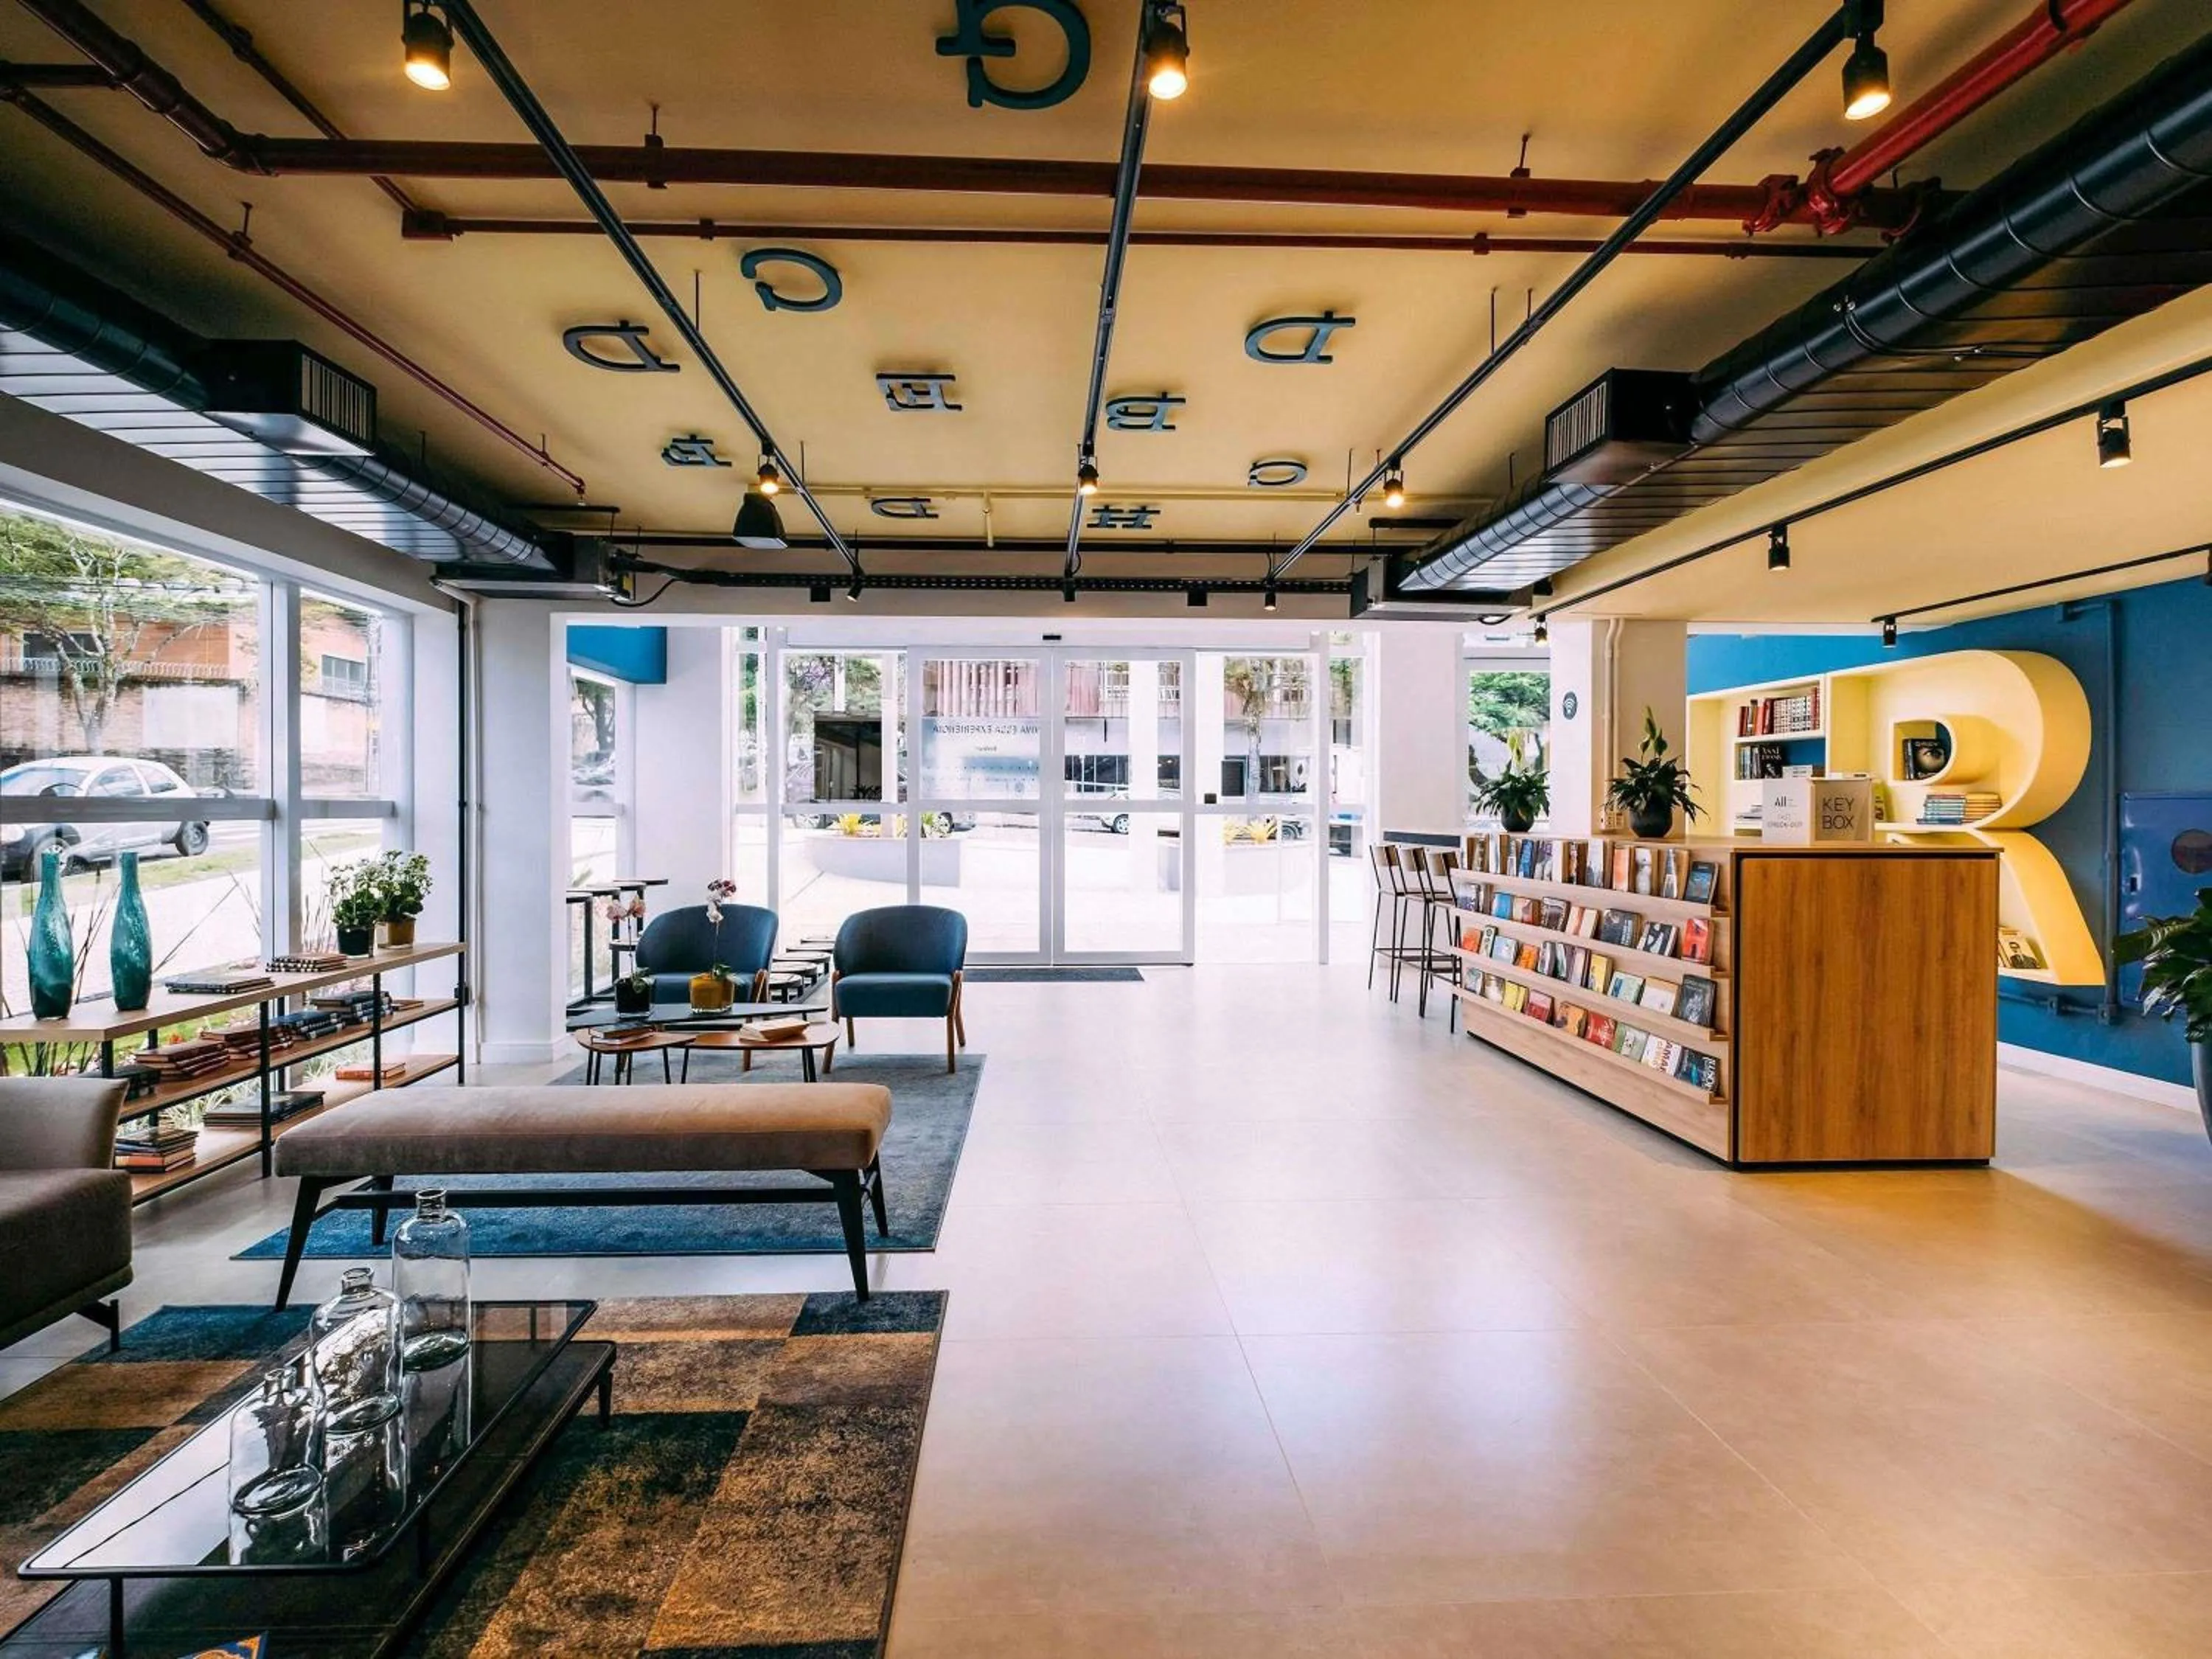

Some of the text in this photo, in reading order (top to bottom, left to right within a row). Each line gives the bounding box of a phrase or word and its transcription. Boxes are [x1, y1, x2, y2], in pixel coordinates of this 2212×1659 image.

[936, 0, 1091, 109] G
[740, 247, 843, 312] C
[563, 321, 681, 372] D
[1245, 312, 1355, 364] D
[875, 372, 963, 411] E
[1106, 392, 1186, 432] B
[1086, 504, 1161, 530] H
[1775, 796, 1787, 807] All
[1822, 797, 1854, 812] KEY
[1822, 815, 1854, 830] BOX
